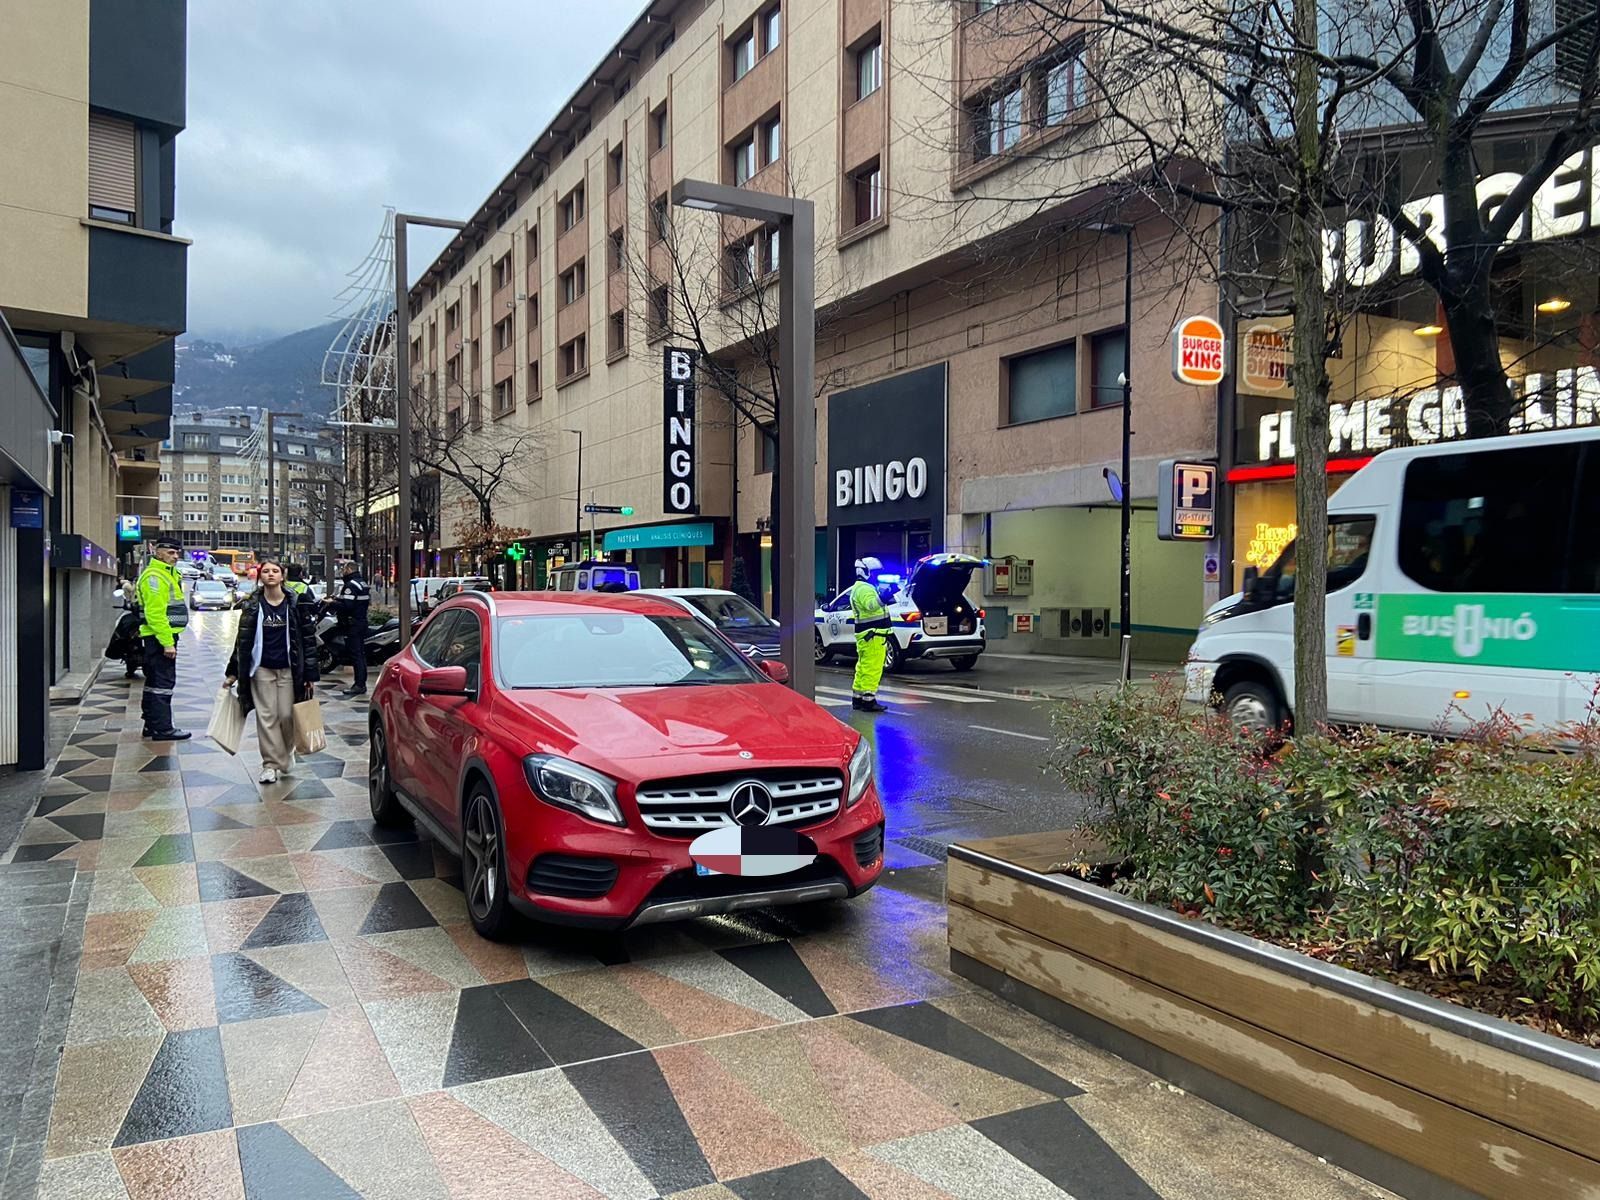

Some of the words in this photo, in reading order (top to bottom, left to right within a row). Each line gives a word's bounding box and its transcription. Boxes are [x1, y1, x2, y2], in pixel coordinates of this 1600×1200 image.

[1182, 337, 1222, 353] BURGER
[1182, 350, 1222, 370] KING
[670, 351, 691, 510] BINGO
[1259, 398, 1392, 461] FLME
[836, 457, 927, 507] BINGO
[1181, 470, 1210, 508] P
[122, 515, 138, 531] P
